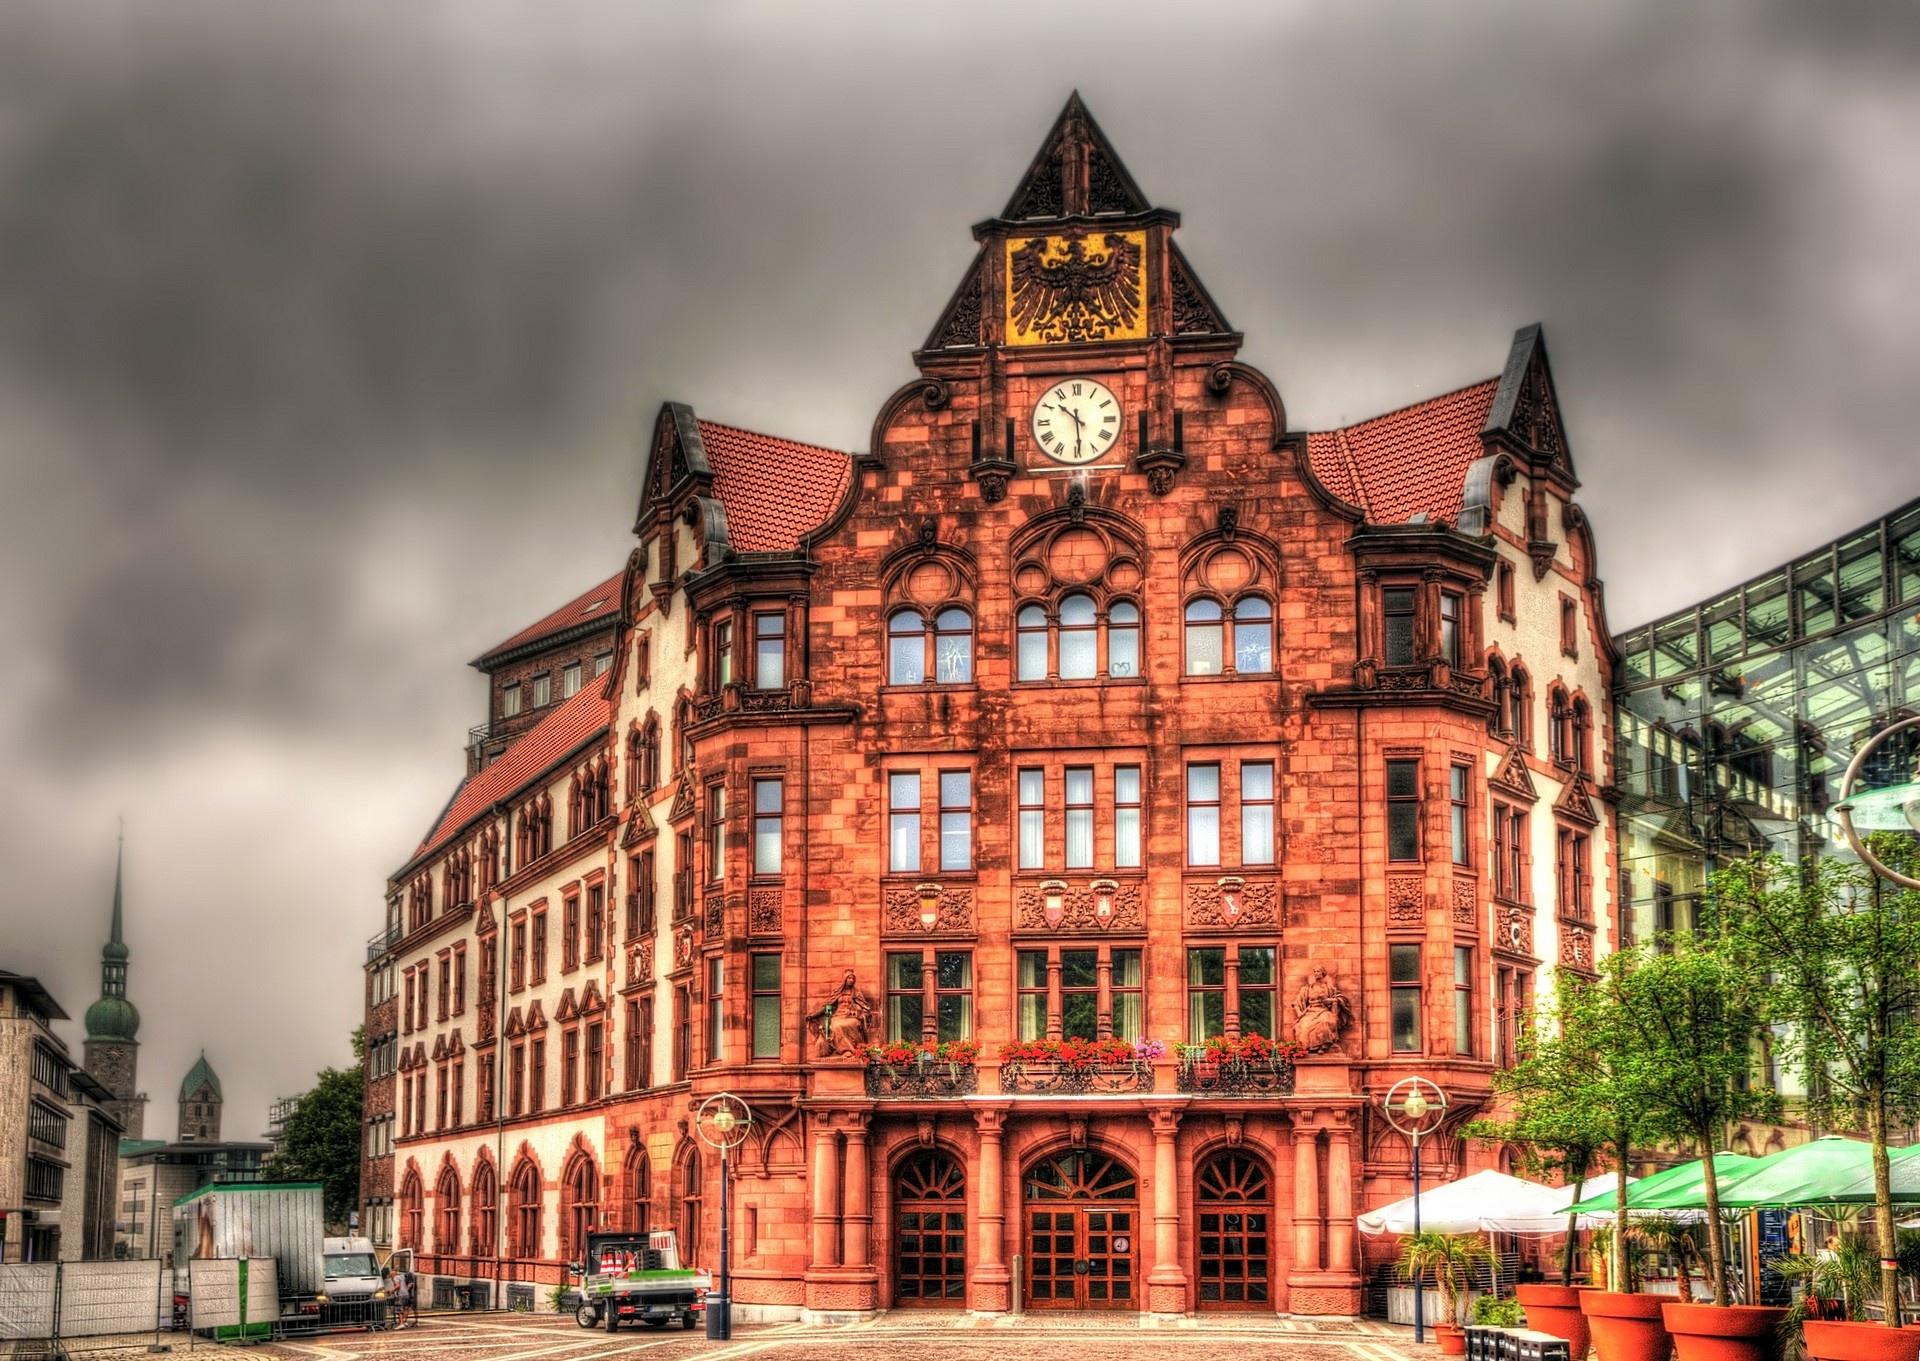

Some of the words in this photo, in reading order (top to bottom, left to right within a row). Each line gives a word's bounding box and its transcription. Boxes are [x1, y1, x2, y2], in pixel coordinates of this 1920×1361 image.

[1054, 388, 1066, 401] XI
[1072, 383, 1082, 396] XII
[1090, 387, 1098, 399] I
[1042, 402, 1055, 411] X
[1099, 399, 1112, 409] II
[1090, 443, 1098, 454] V
[1143, 1179, 1150, 1188] 5
